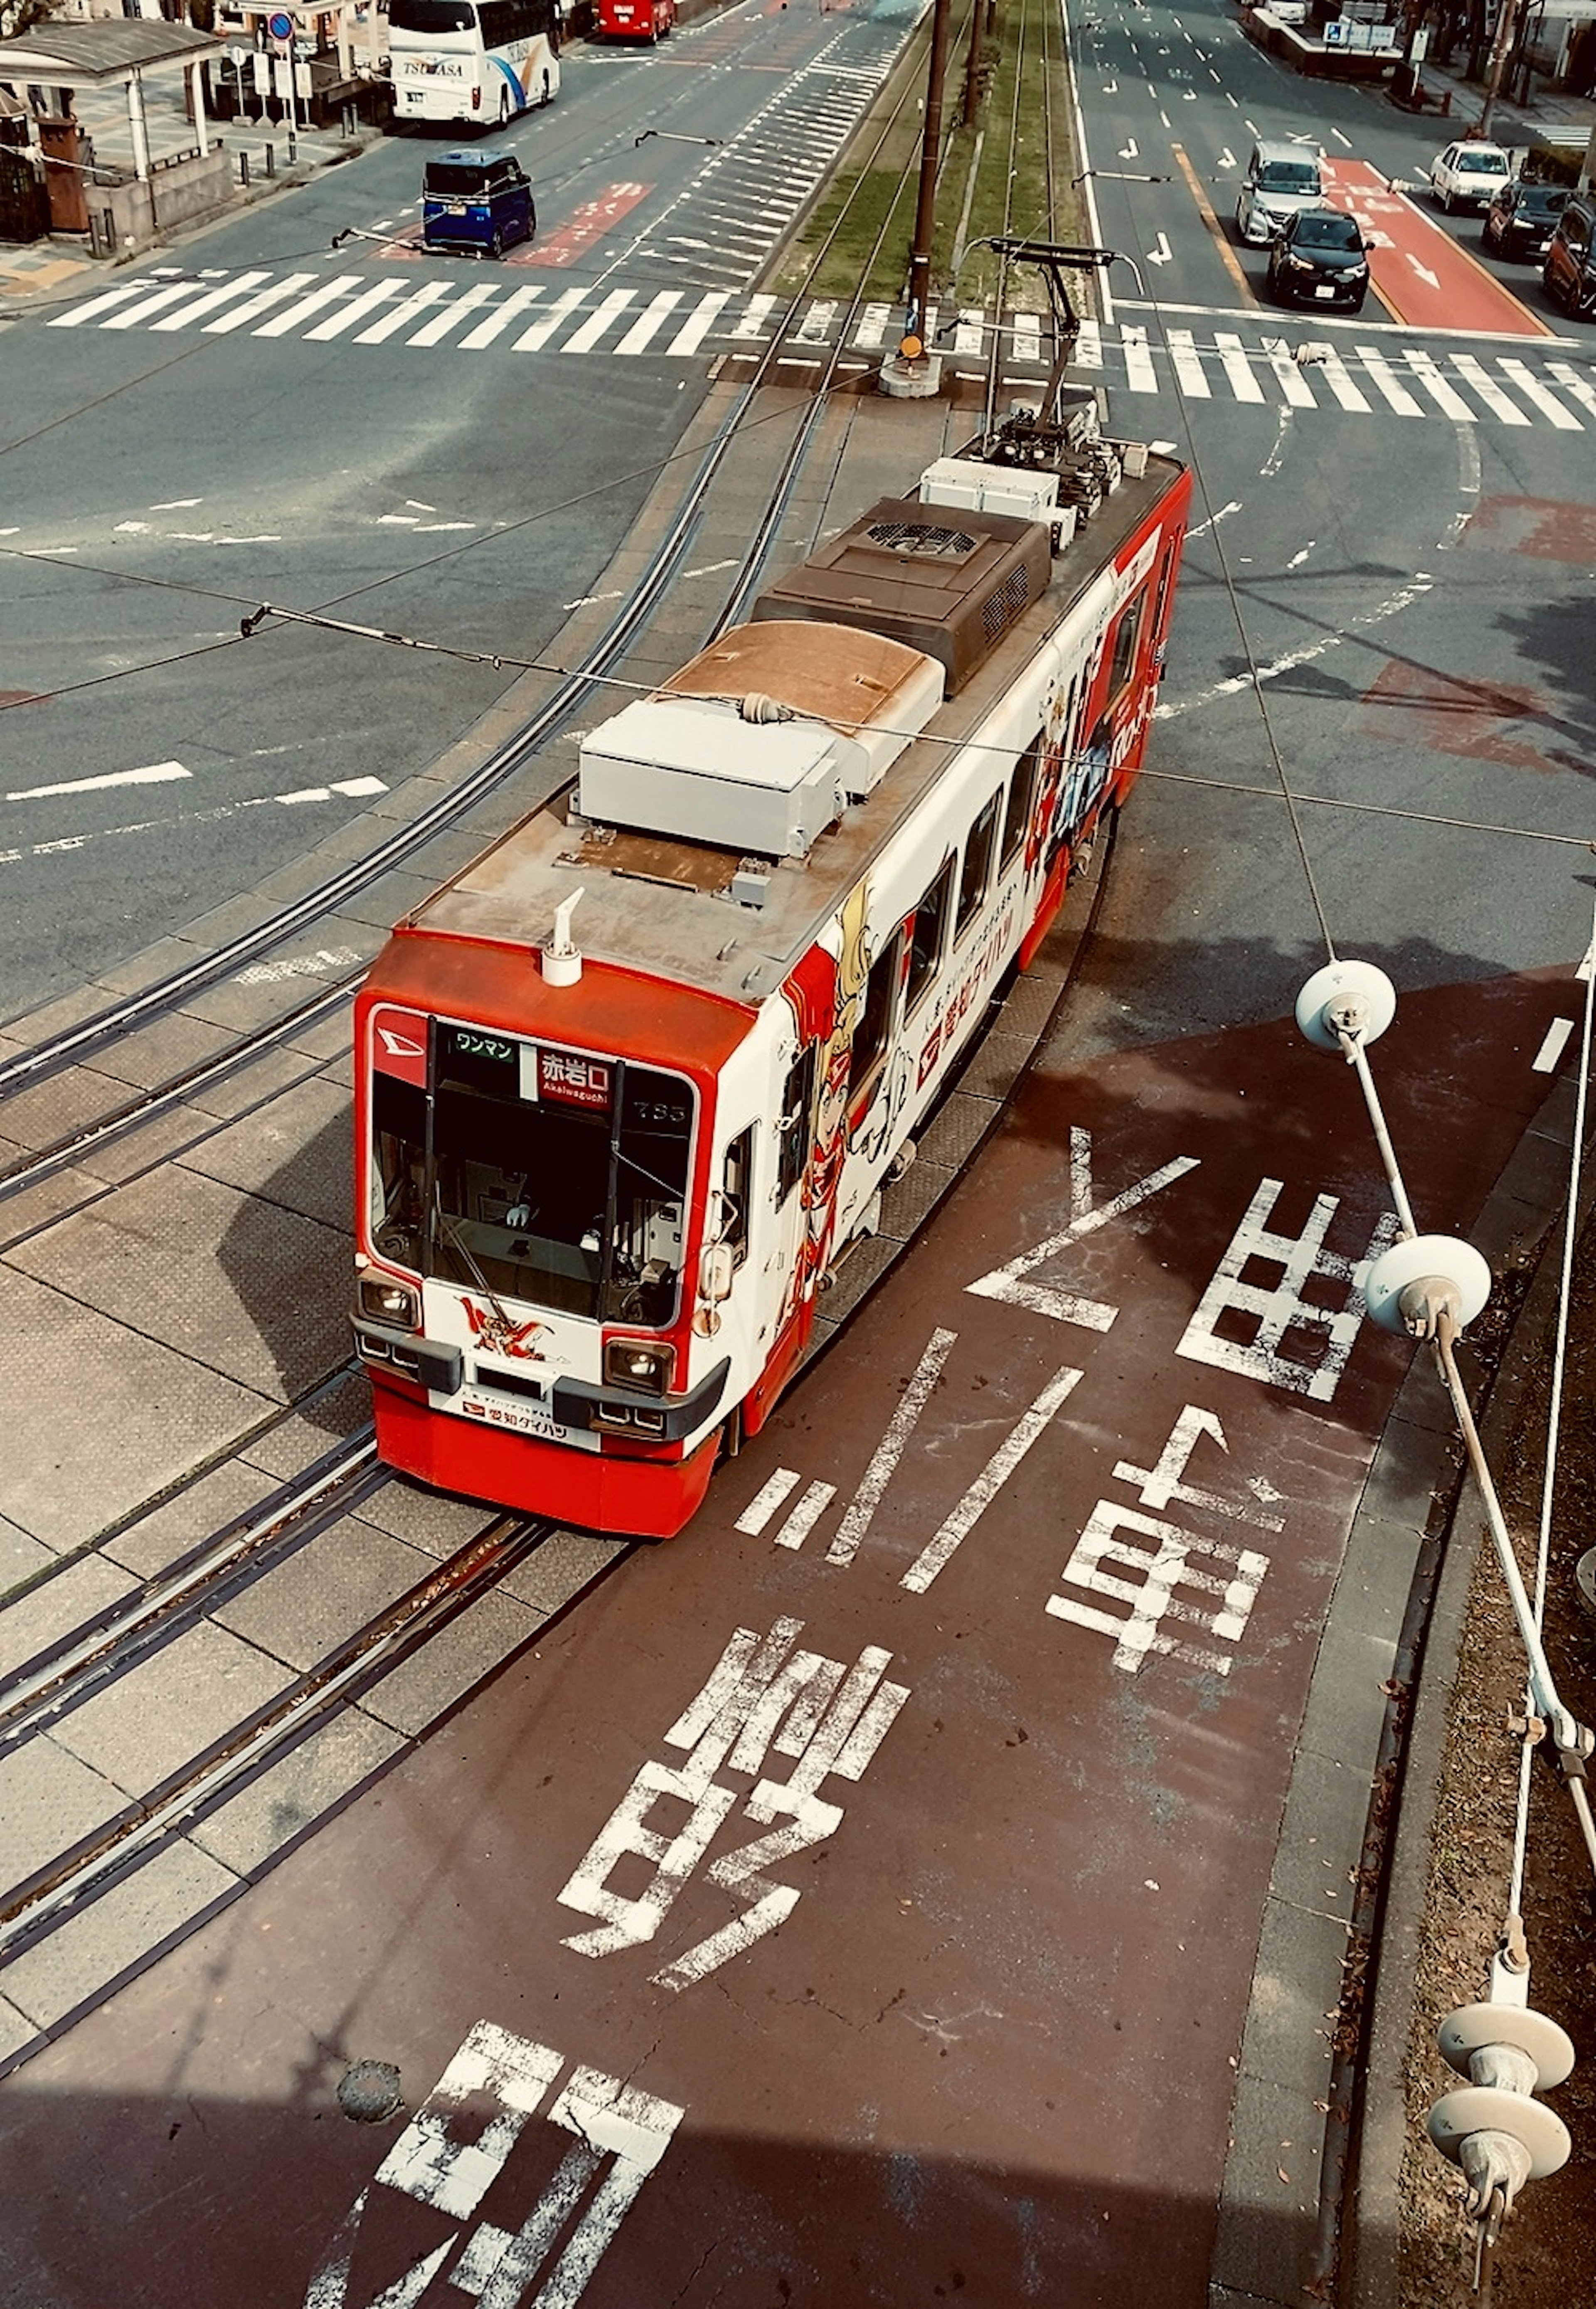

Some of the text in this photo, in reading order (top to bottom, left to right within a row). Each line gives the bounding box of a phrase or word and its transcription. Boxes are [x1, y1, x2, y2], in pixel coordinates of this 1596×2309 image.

[457, 1033, 512, 1059] ワンマン
[542, 1054, 609, 1092] 赤岩口
